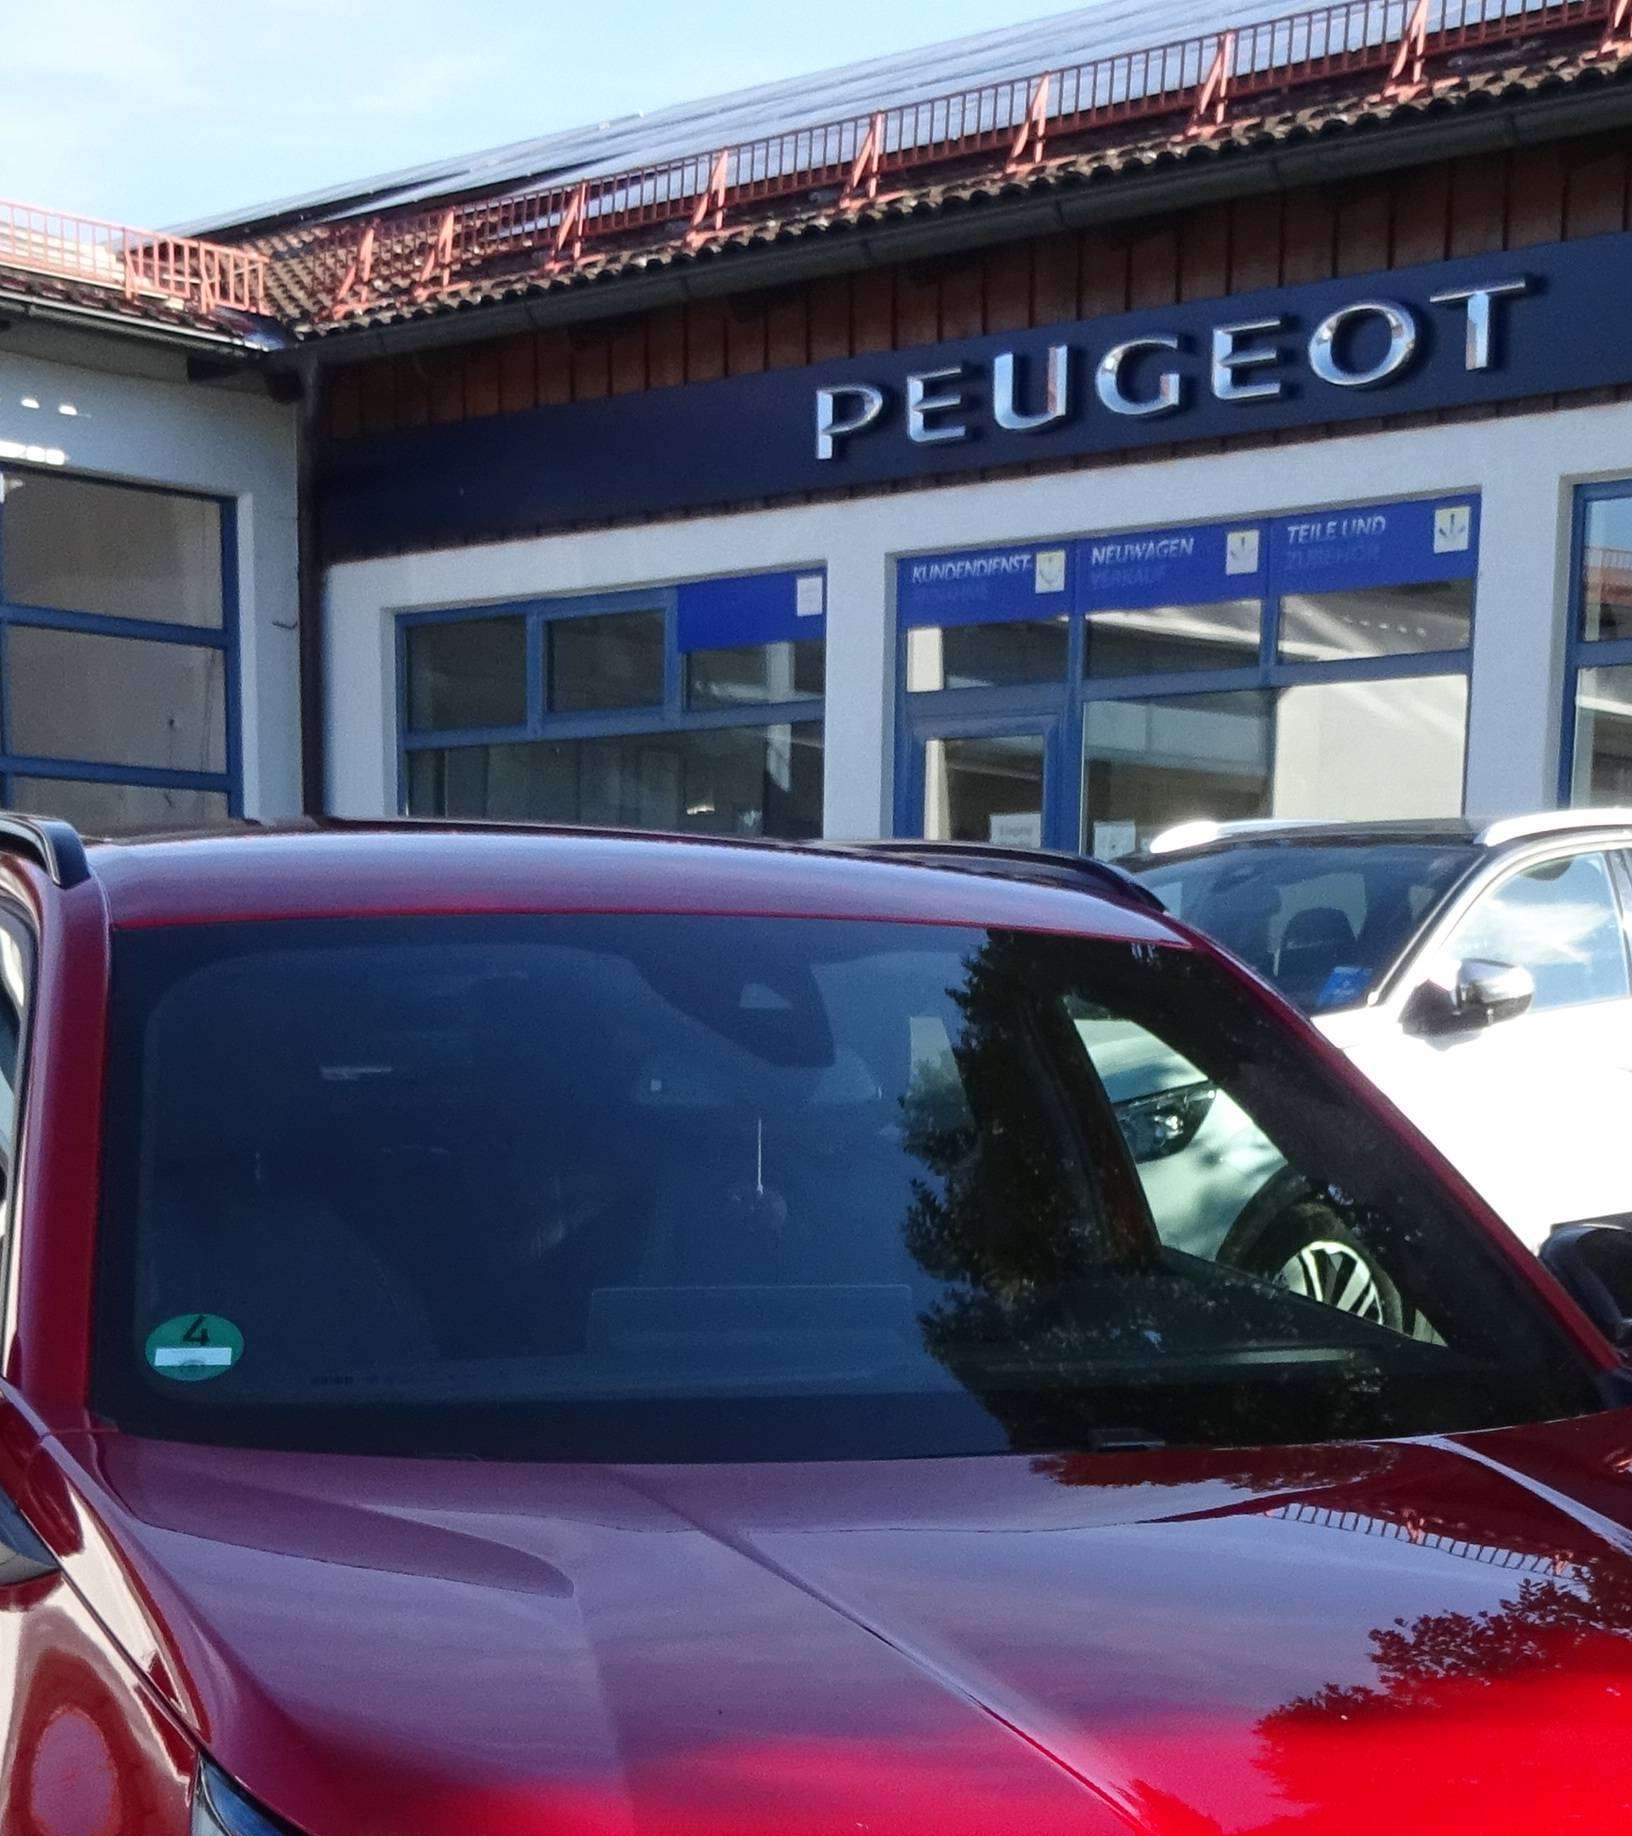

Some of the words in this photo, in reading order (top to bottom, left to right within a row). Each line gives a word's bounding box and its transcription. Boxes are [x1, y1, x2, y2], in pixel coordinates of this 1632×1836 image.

[815, 279, 1528, 461] PEUGEOT
[1287, 519, 1338, 545] TEILE
[1341, 515, 1387, 538] UND
[1091, 537, 1195, 566] NEUWAGEN
[181, 1314, 210, 1346] 4
